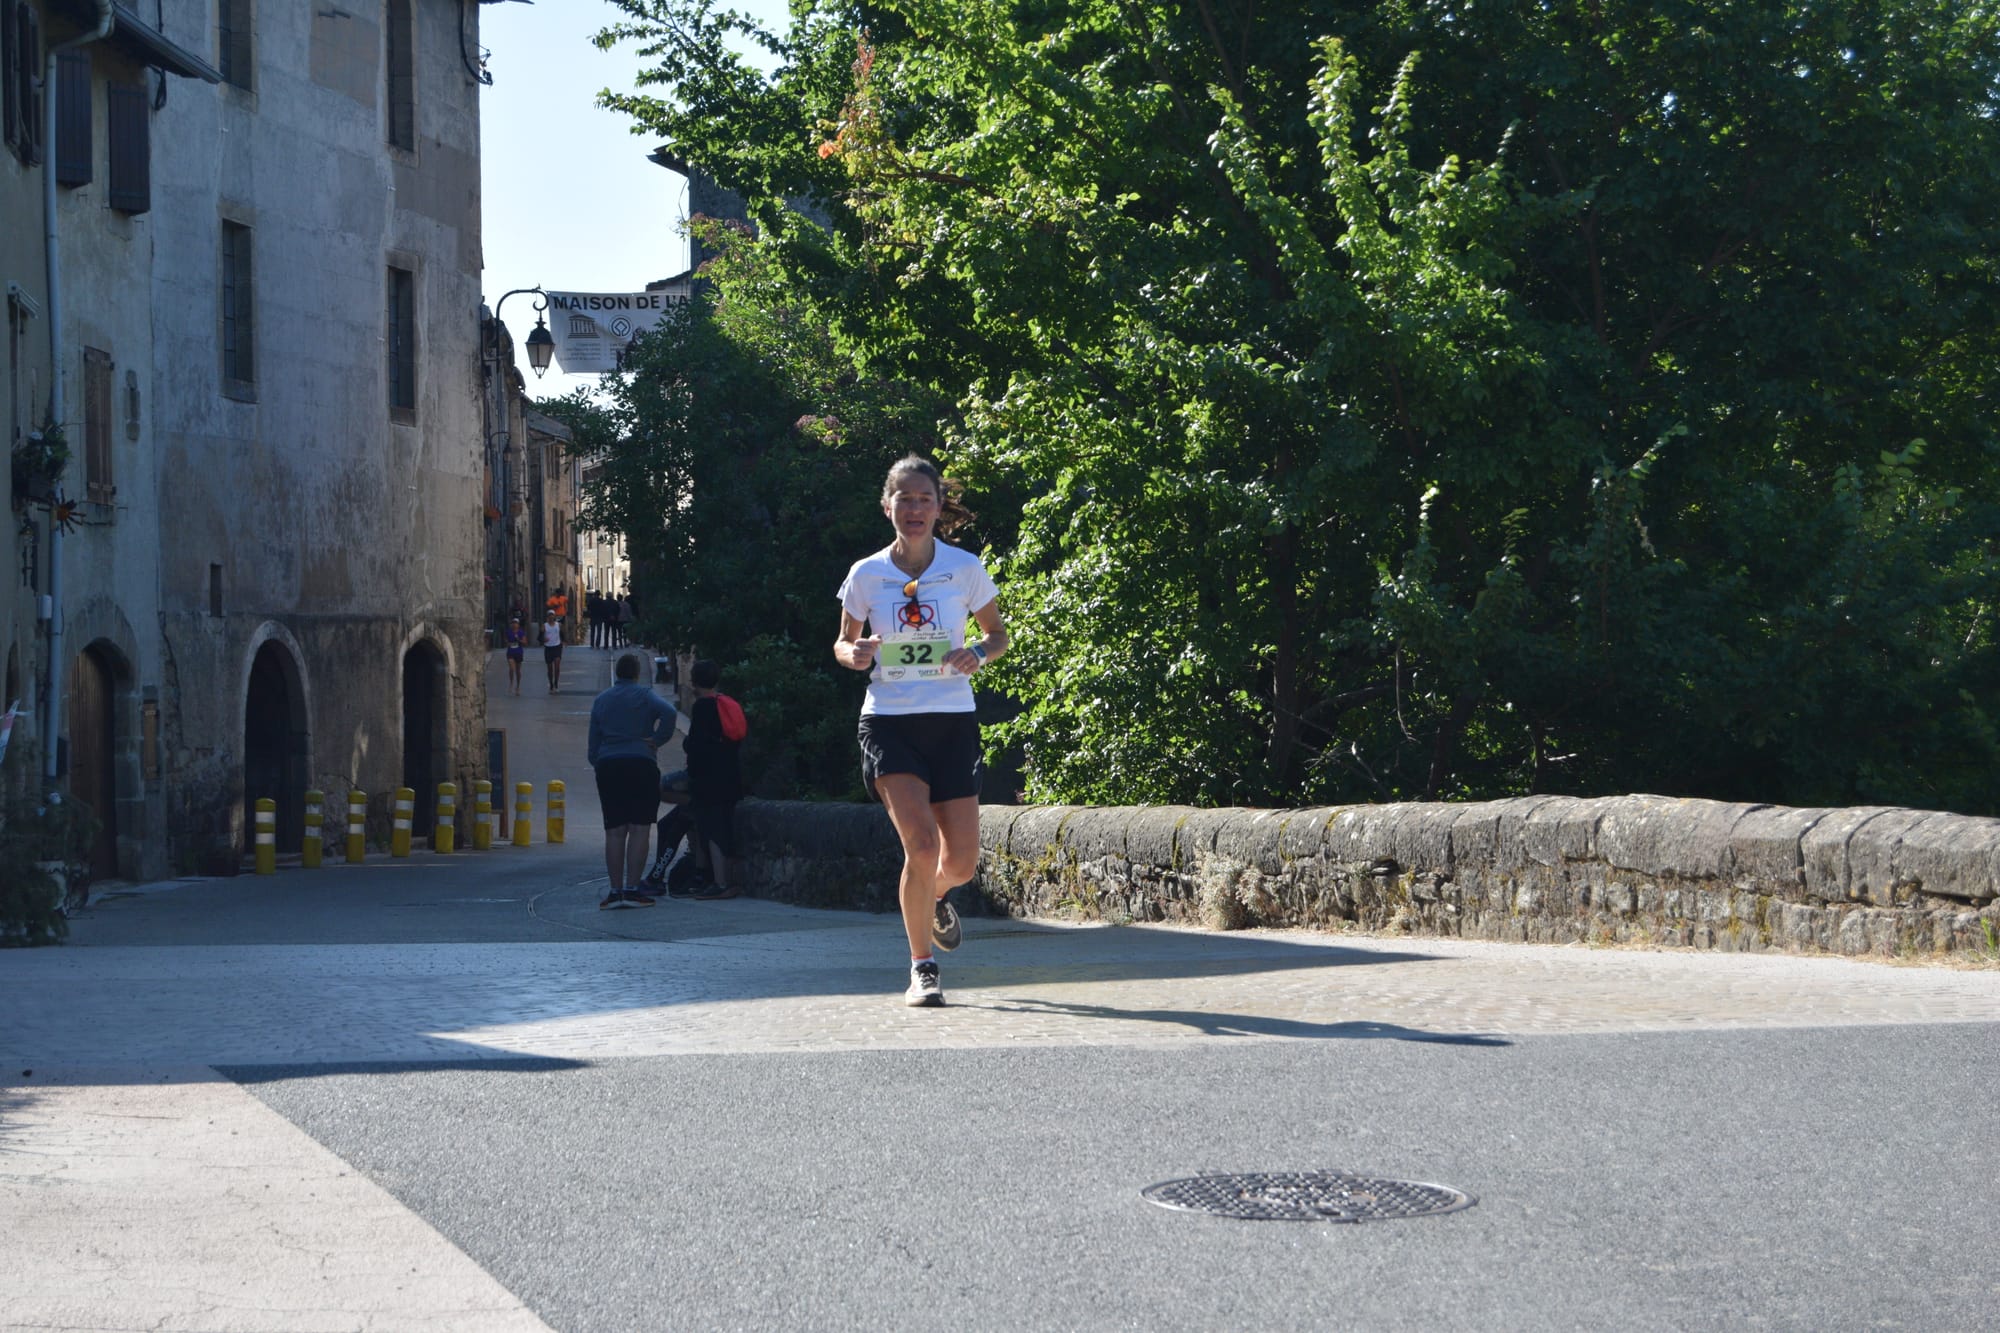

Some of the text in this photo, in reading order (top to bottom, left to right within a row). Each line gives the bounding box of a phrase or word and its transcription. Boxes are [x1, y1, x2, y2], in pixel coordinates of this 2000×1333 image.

[554, 294, 688, 310] MAISON DE L'A
[900, 644, 933, 665] 32
[652, 848, 673, 879] adidas
